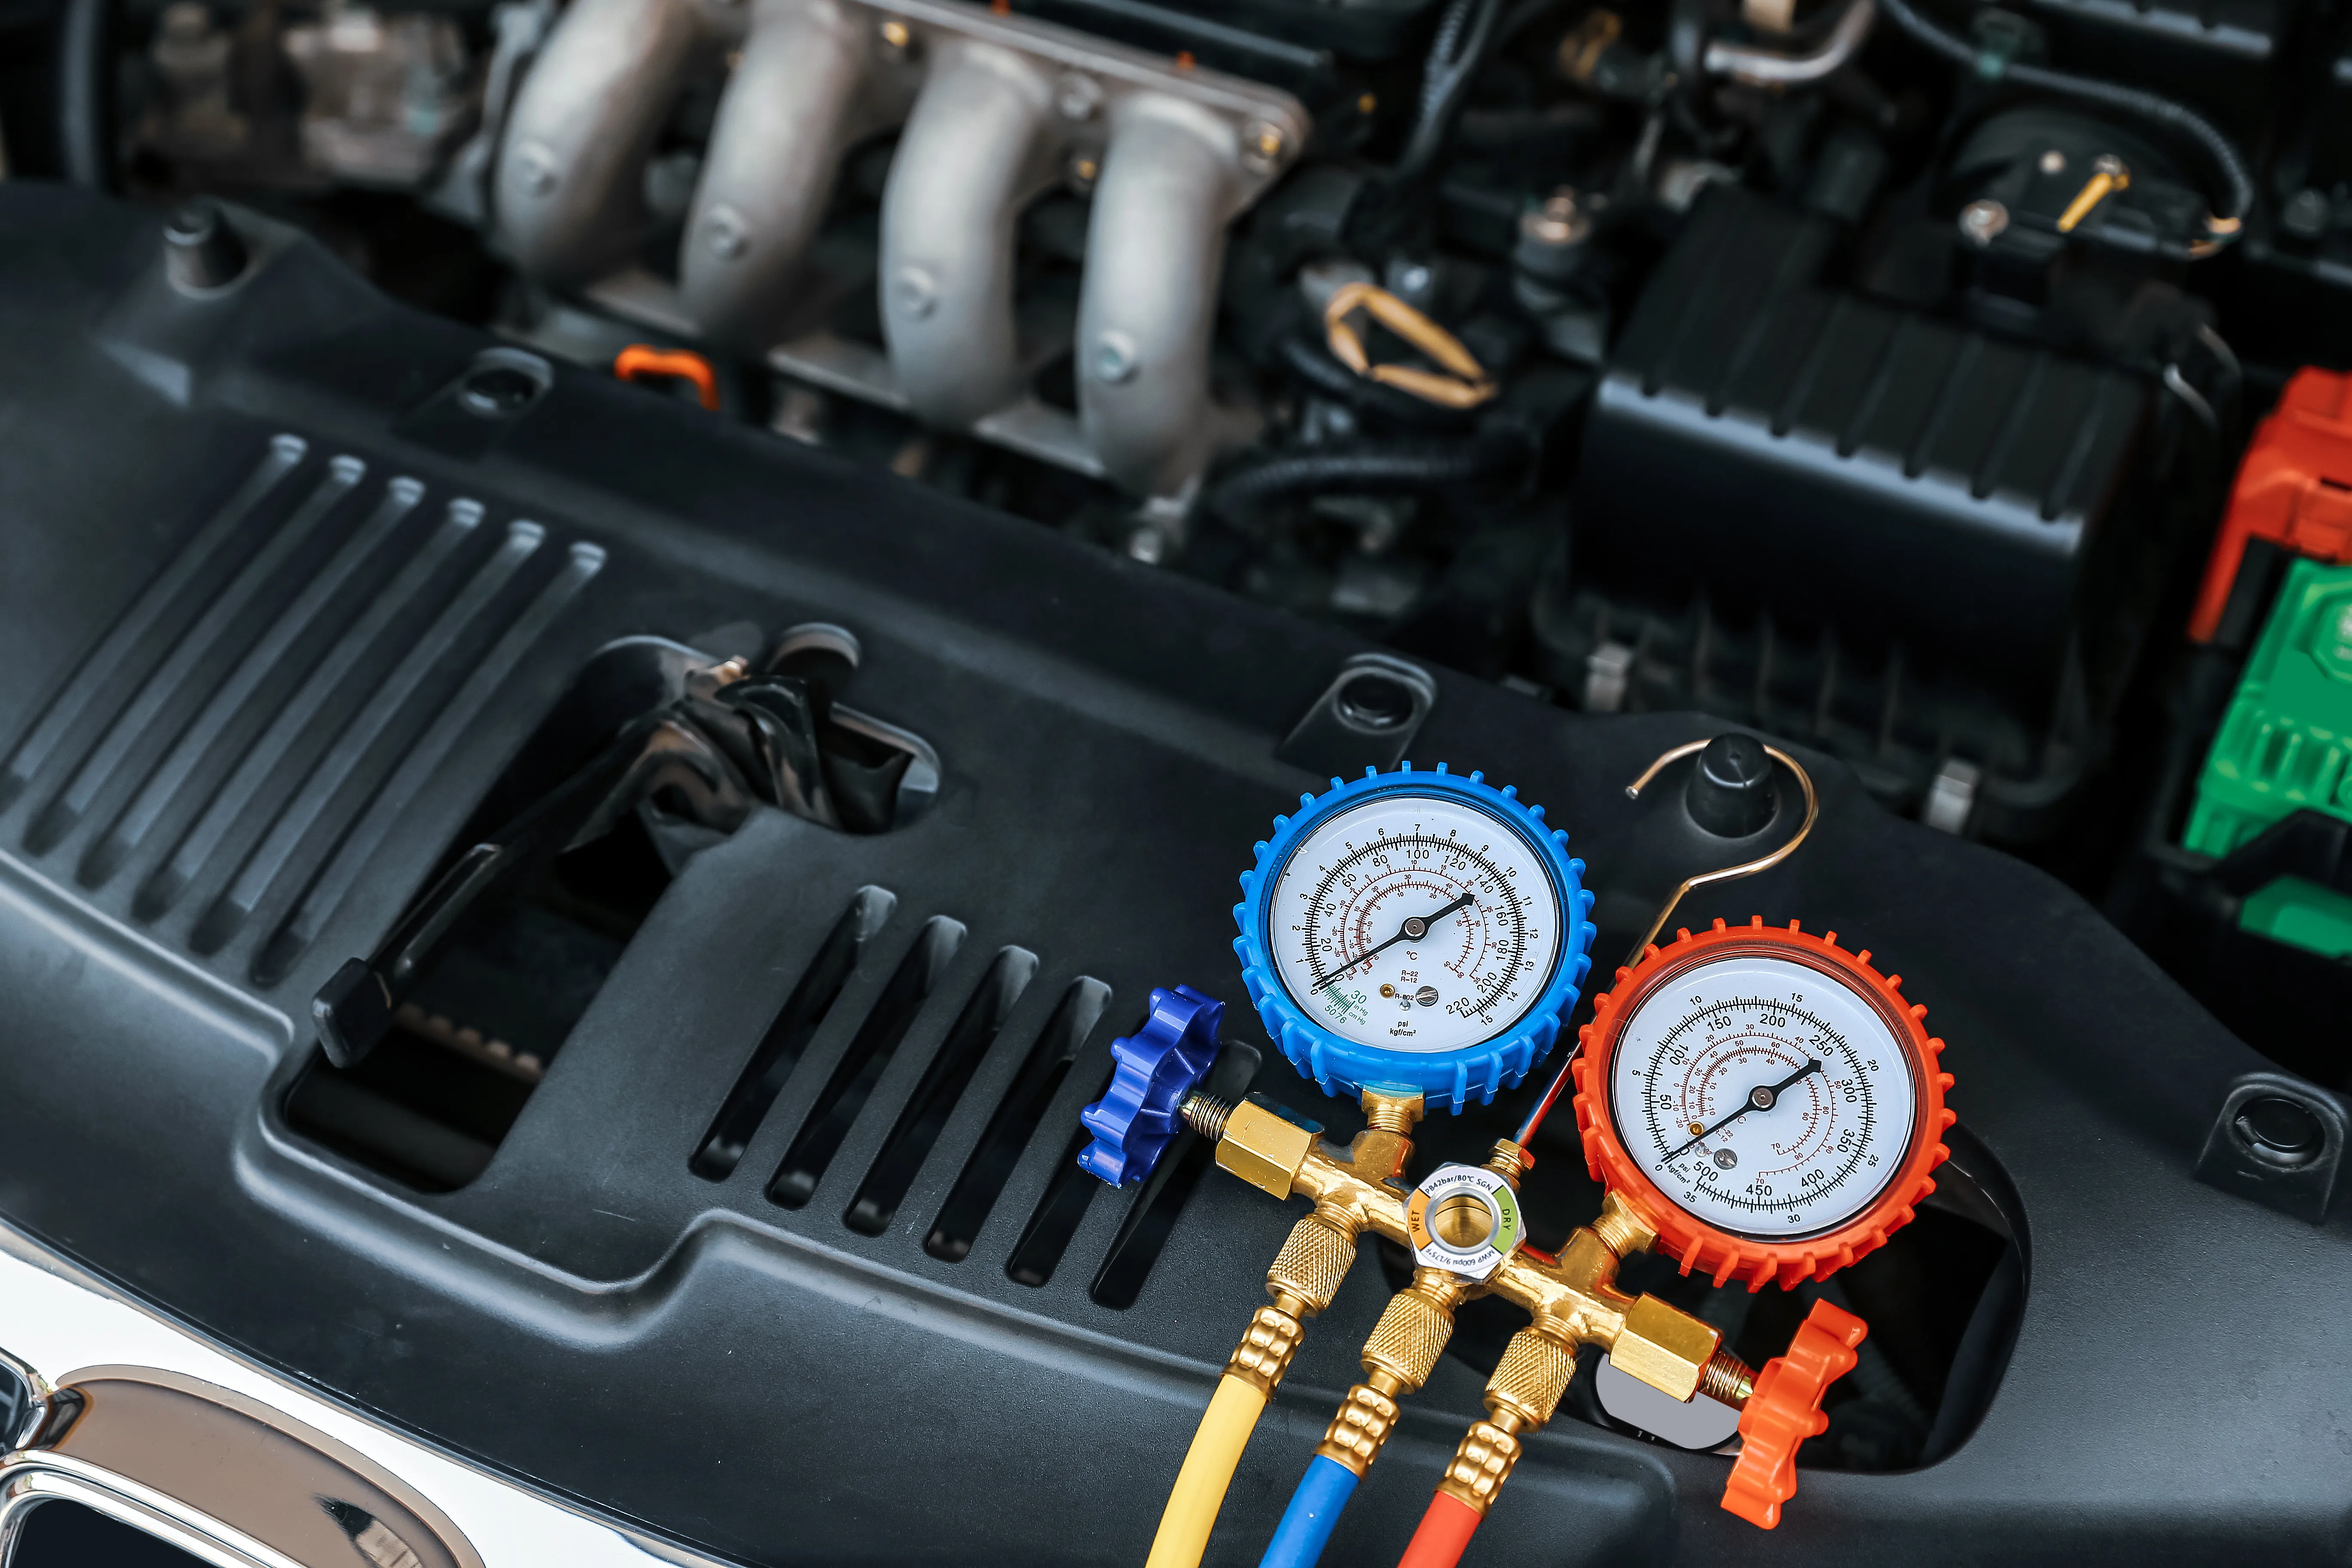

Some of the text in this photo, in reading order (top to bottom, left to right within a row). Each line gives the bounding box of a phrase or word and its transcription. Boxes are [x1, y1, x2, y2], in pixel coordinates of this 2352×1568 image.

[1406, 850, 1429, 859] 100
[1372, 855, 1388, 867] 80
[1445, 855, 1466, 870] 120
[1506, 867, 1516, 877] 10
[1342, 874, 1357, 887] 60
[1475, 874, 1494, 893] 140
[1523, 896, 1533, 906] 11
[1324, 903, 1336, 917] 40
[1495, 905, 1508, 926] 160
[1530, 928, 1538, 939] 12
[1321, 938, 1332, 951] 20
[1496, 940, 1509, 960] 180
[1406, 951, 1417, 960] °C
[1524, 961, 1534, 971] 13
[1477, 972, 1497, 993] 200
[1351, 990, 1367, 1004] 30
[1507, 991, 1518, 1001] 14
[1690, 995, 1702, 1005] 10
[1792, 992, 1803, 1002] 15
[1446, 998, 1469, 1014] 220
[1481, 1015, 1493, 1026] 15
[1707, 1016, 1731, 1032] 150
[1760, 1014, 1785, 1028] 200
[1705, 1034, 1715, 1042] 20
[1809, 1035, 1833, 1057] 250
[1669, 1044, 1689, 1065] 100
[1710, 1050, 1718, 1059] 40
[1719, 1067, 1727, 1075] 20
[1867, 1060, 1879, 1071] 20
[1694, 1068, 1703, 1076] 30
[1689, 1085, 1696, 1094] 20
[1841, 1079, 1857, 1102] 300
[1660, 1094, 1672, 1110] 50
[1689, 1101, 1695, 1109] 10
[1837, 1129, 1855, 1153] 350
[1868, 1154, 1879, 1167] 25
[1678, 1163, 1690, 1173] psi
[1694, 1161, 1718, 1182] 500
[1801, 1169, 1825, 1187] 400
[1476, 1179, 1493, 1191] SGN
[1746, 1184, 1772, 1196] 450
[1684, 1191, 1697, 1203] 35
[1412, 1210, 1420, 1233] WET
[1502, 1208, 1511, 1231] DRY
[1788, 1214, 1801, 1223] 30
[1478, 1249, 1495, 1262] MWP
